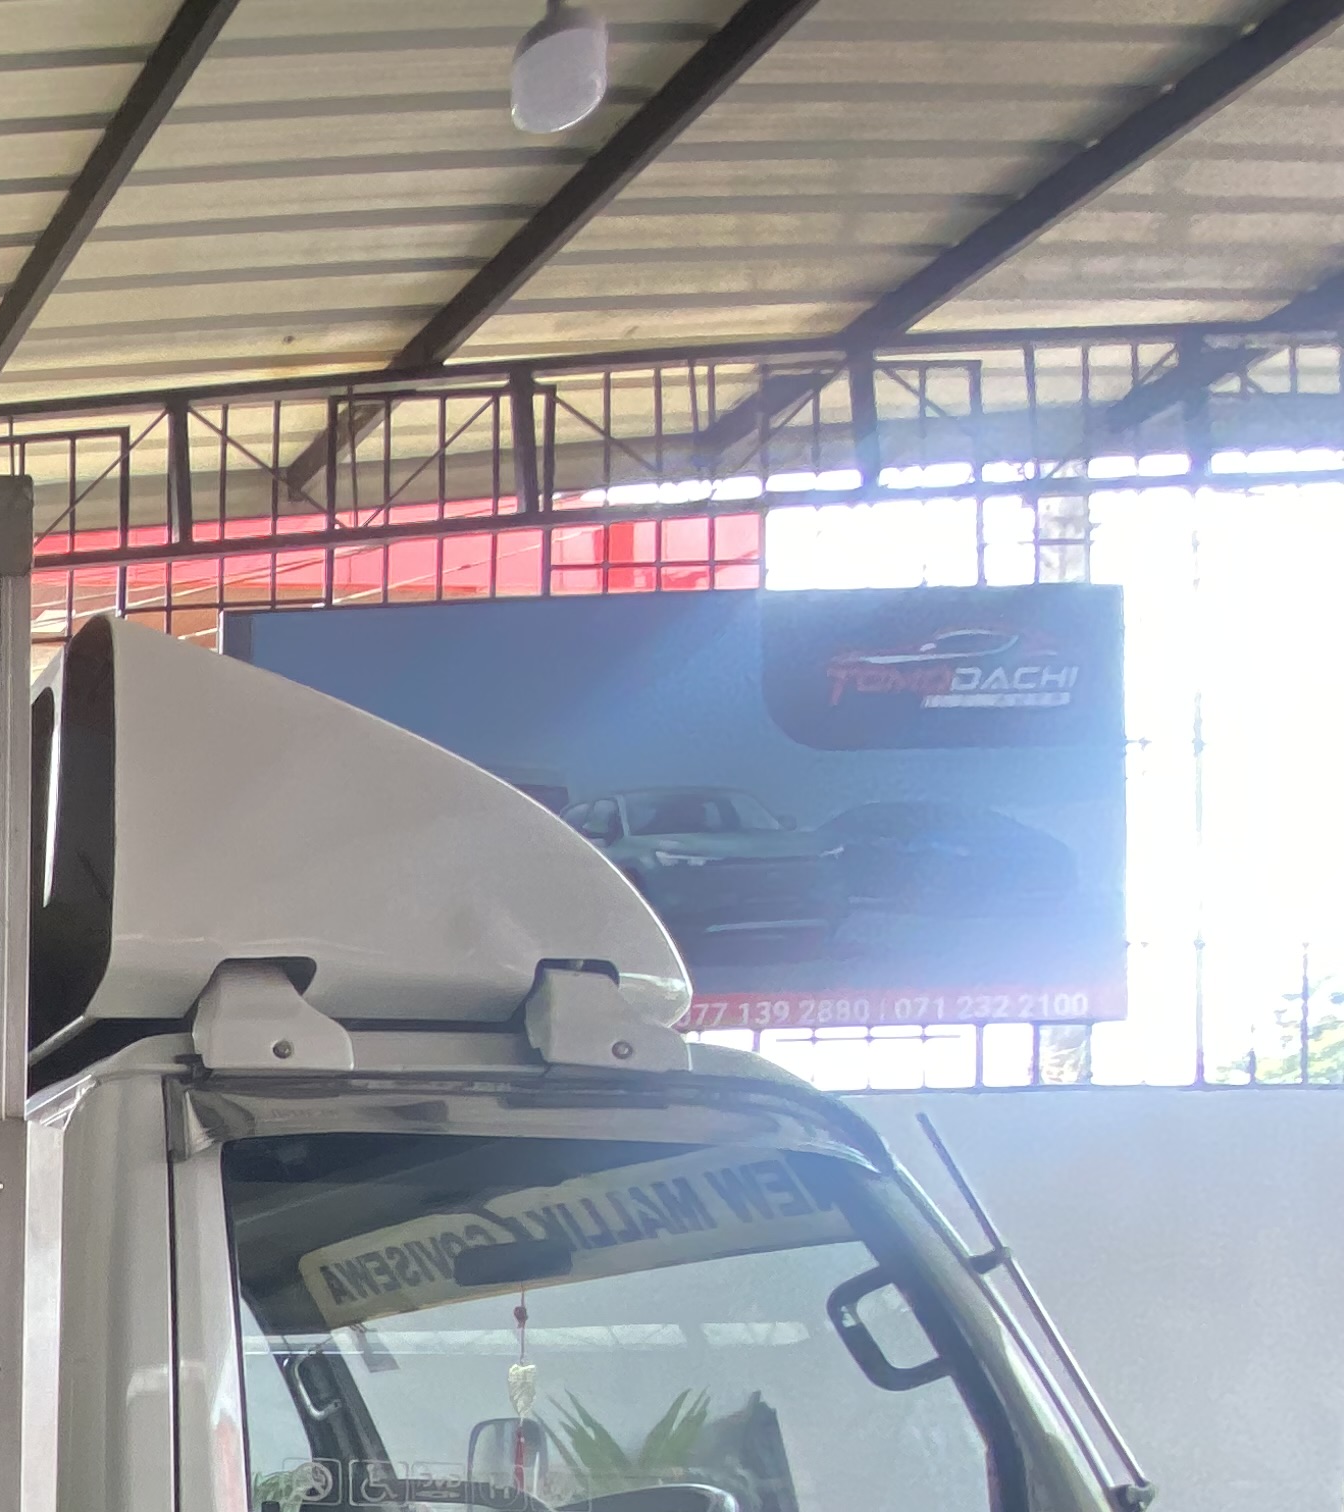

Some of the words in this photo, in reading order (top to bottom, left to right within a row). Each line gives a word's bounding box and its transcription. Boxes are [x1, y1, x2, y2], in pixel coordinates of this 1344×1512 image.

[739, 1001, 790, 1026] 139
[799, 999, 870, 1024] 2880
[894, 998, 945, 1020] 071
[956, 995, 1010, 1018] 232
[1018, 991, 1089, 1017] 2100
